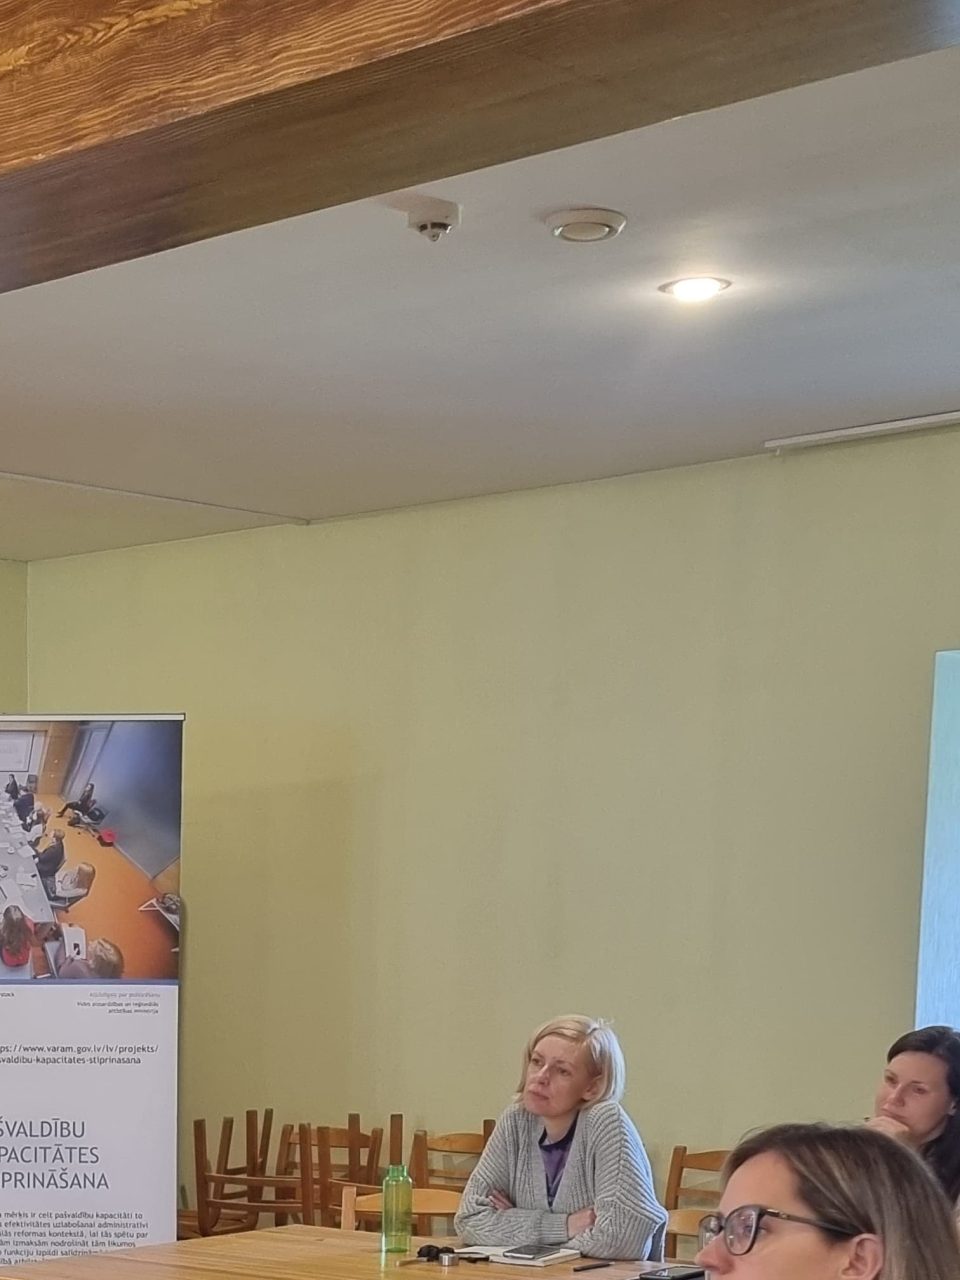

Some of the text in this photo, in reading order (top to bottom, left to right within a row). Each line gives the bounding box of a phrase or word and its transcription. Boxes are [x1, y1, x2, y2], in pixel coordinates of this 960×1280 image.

[54, 1210, 94, 1220] pašvaldību
[49, 1231, 87, 1239] kontekstā,
[114, 1231, 135, 1239] spētu
[108, 1240, 136, 1248] likumos
